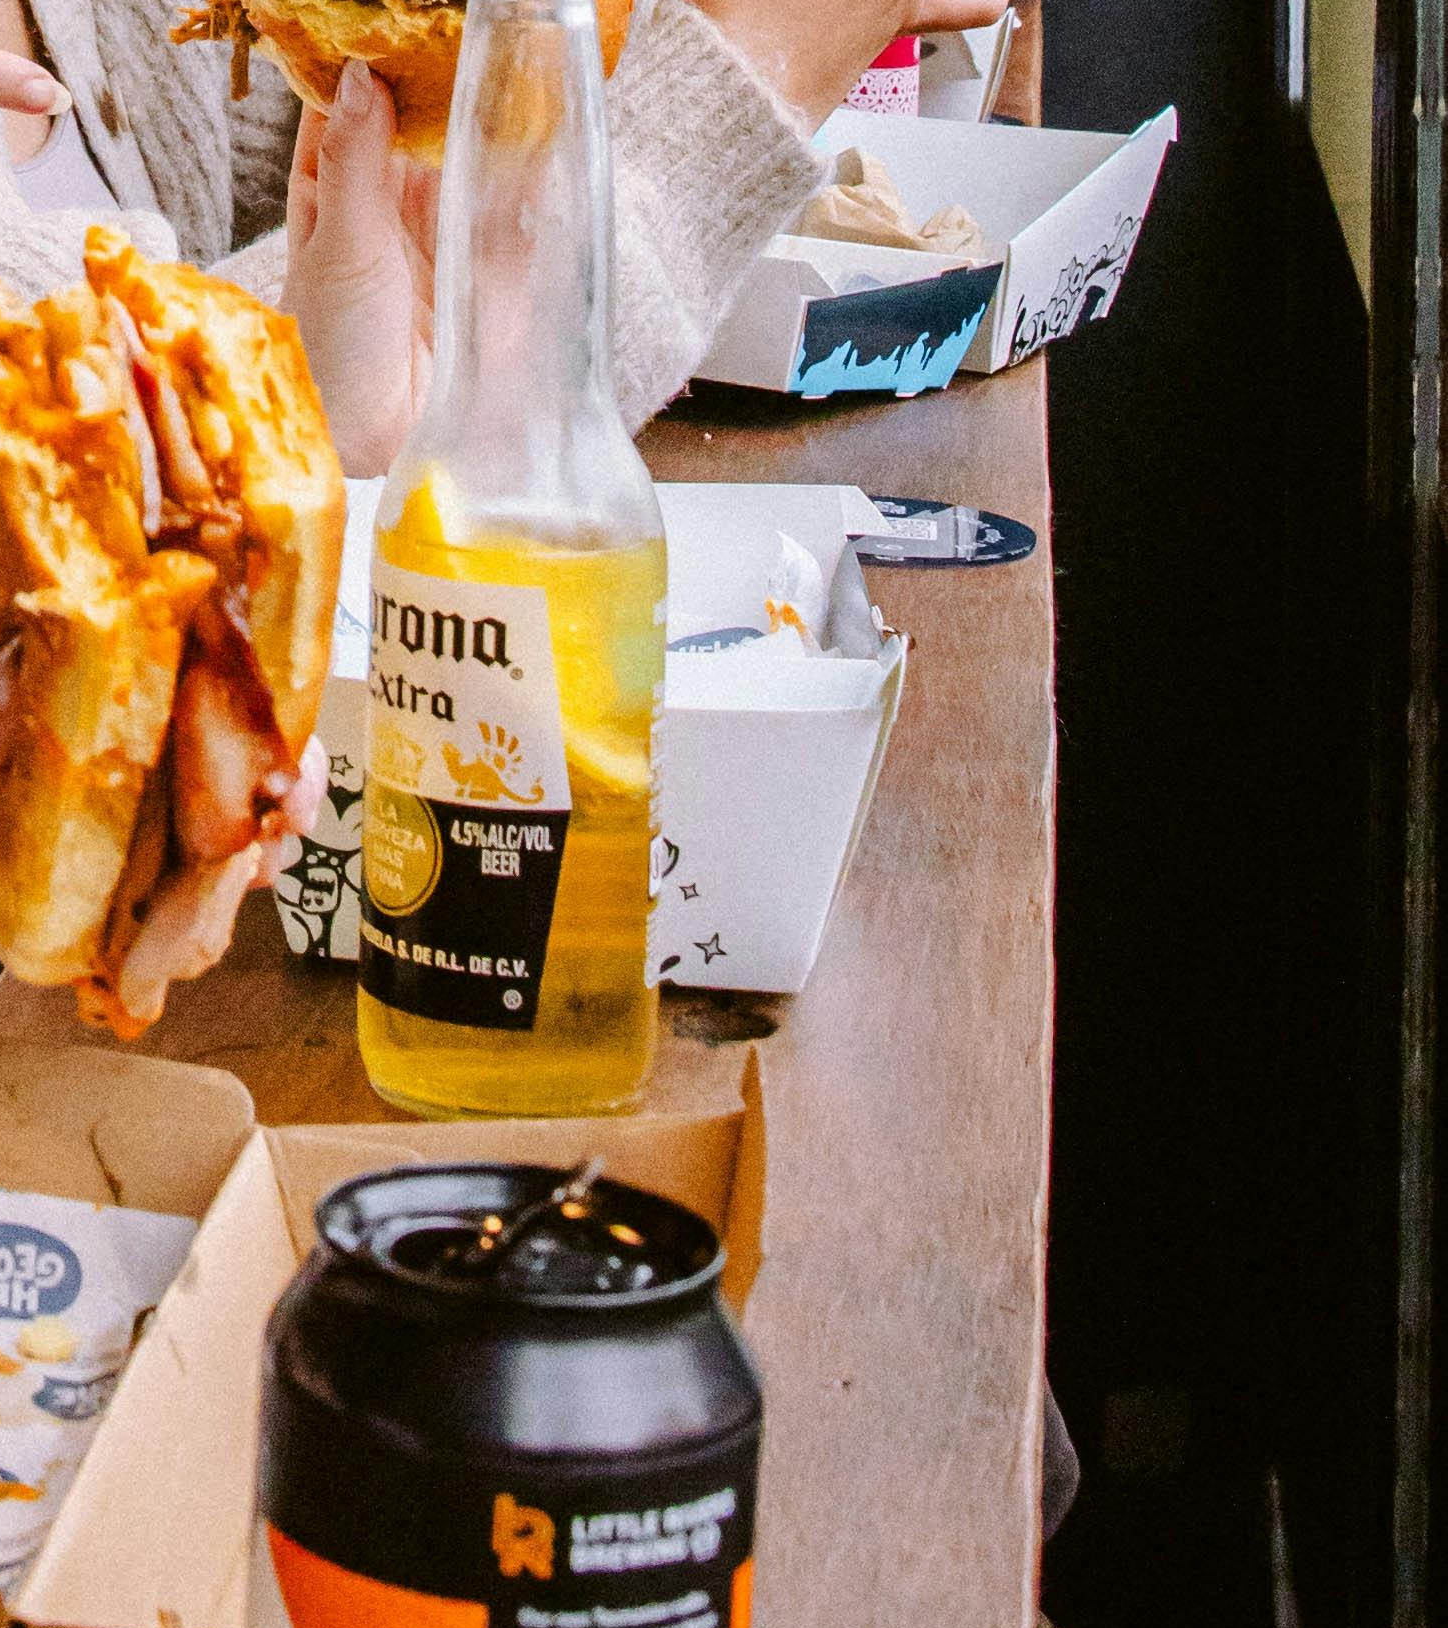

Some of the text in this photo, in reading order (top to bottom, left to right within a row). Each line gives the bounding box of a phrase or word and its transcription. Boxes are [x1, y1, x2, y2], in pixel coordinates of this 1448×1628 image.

[481, 849, 521, 877] BEER
[397, 939, 410, 960] S.
[412, 943, 432, 966] DE
[435, 949, 465, 973] R.L.
[468, 955, 493, 975] DE
[496, 957, 530, 979] C.V.
